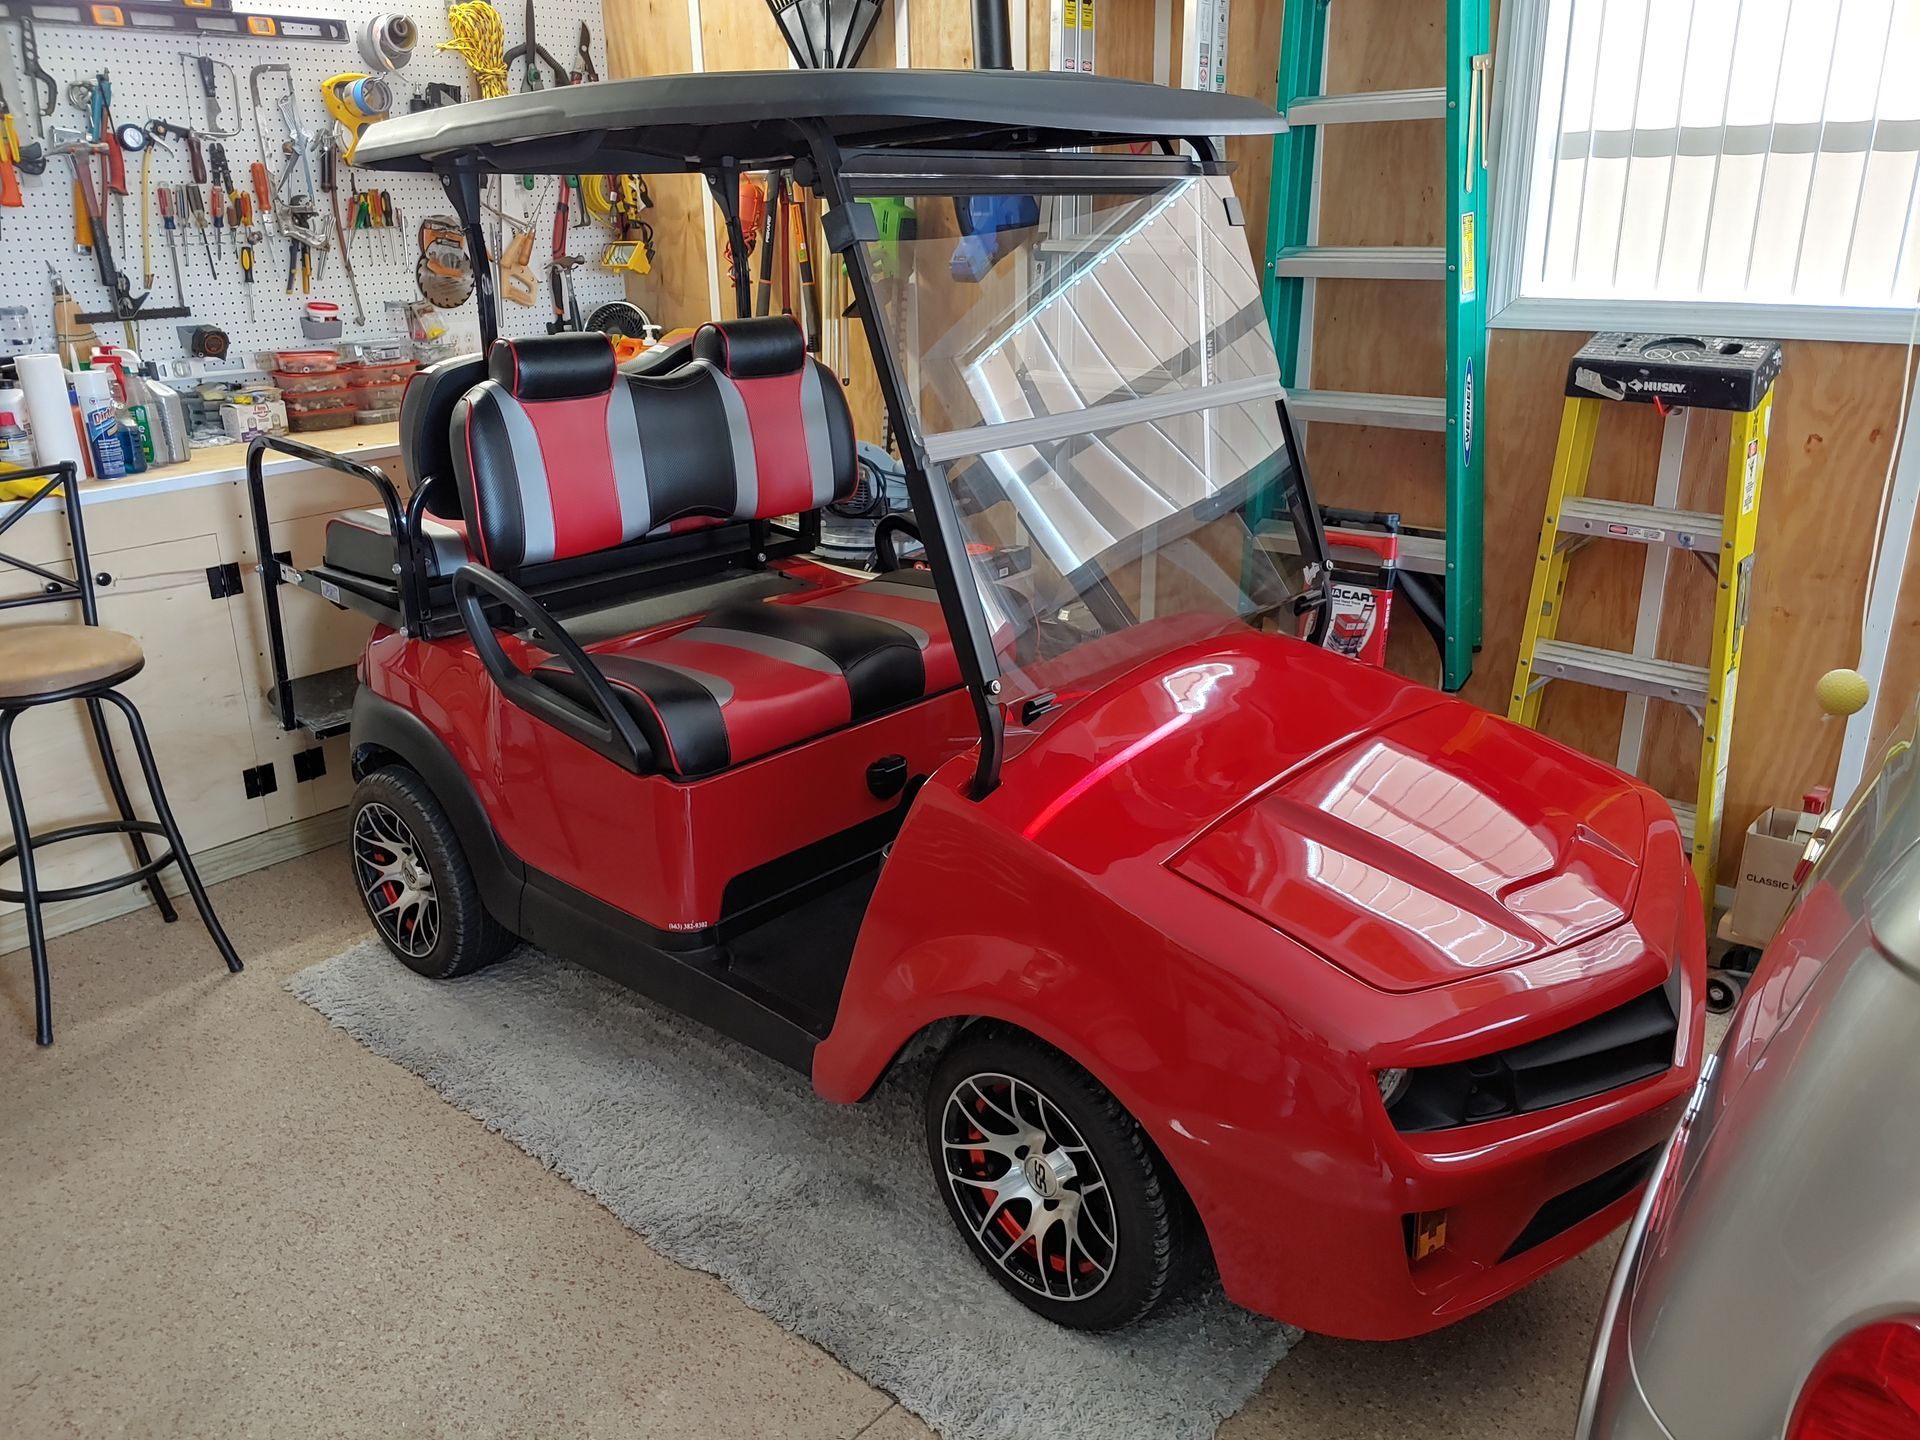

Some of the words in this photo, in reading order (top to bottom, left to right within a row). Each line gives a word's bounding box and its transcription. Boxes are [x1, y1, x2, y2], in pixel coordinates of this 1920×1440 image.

[1643, 380, 1686, 394] HUSKY
[1342, 590, 1378, 603] CART
[1746, 873, 1790, 890] CLASSIC
